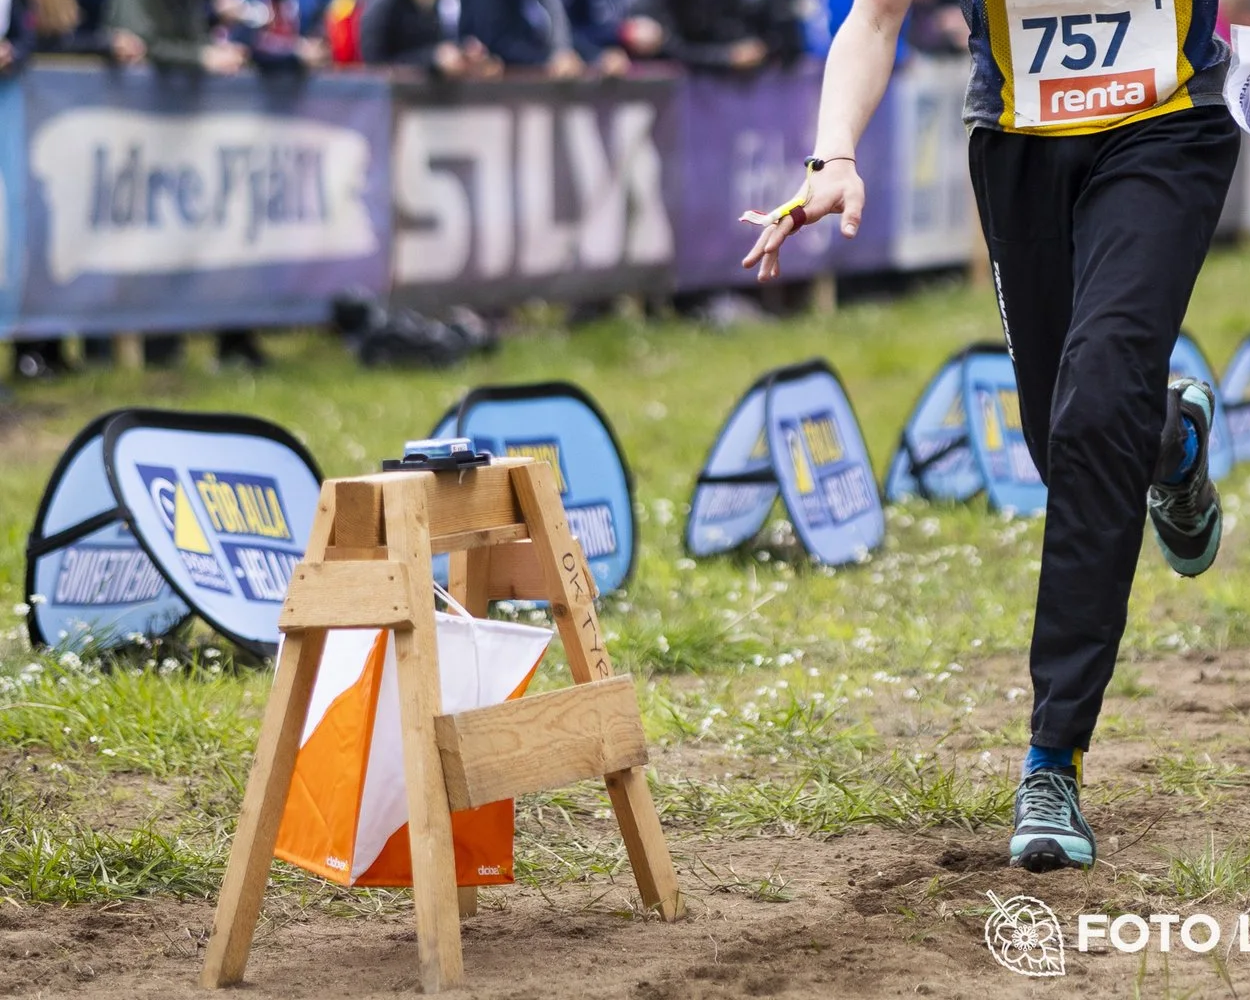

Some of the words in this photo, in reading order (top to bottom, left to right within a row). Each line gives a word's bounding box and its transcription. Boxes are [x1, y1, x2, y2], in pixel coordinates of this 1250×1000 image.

[1022, 11, 1132, 74] 757
[1051, 80, 1146, 113] renta
[196, 472, 248, 534] FÖR
[233, 483, 292, 539] ALLA
